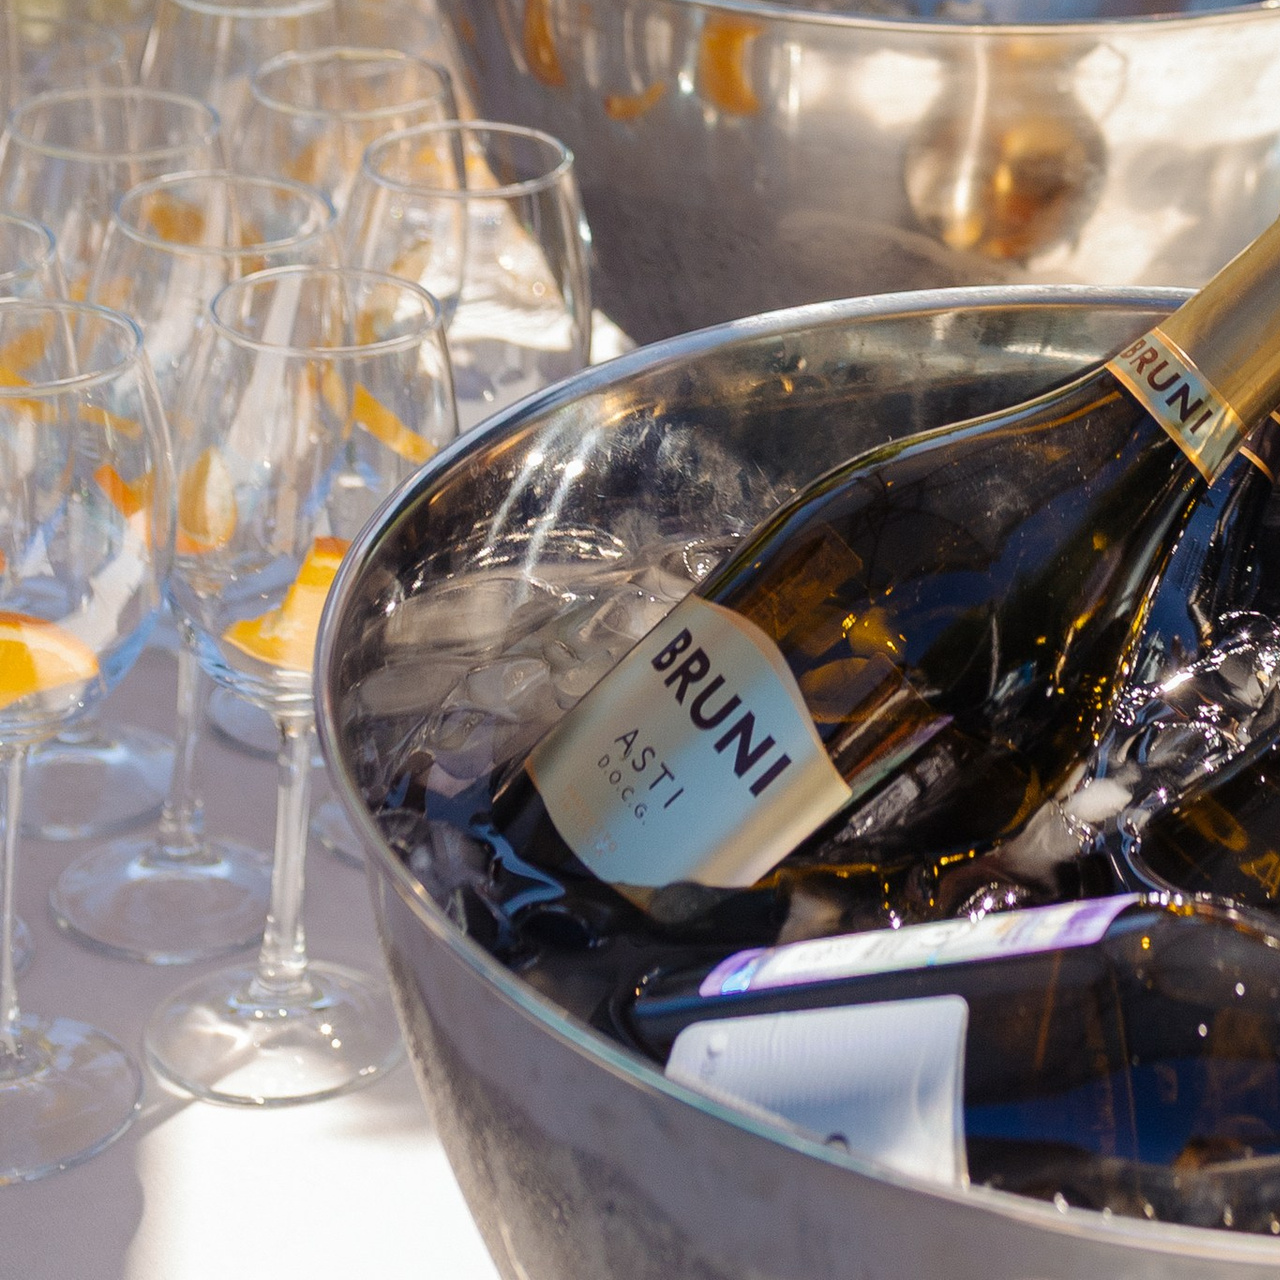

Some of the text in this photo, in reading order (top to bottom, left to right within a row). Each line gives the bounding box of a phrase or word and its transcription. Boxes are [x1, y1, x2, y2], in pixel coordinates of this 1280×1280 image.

[1120, 339, 1213, 434] BRUNI
[651, 627, 792, 798] BRUNI
[597, 753, 649, 826] D.O.C.G.
[614, 729, 685, 809] ASTI
